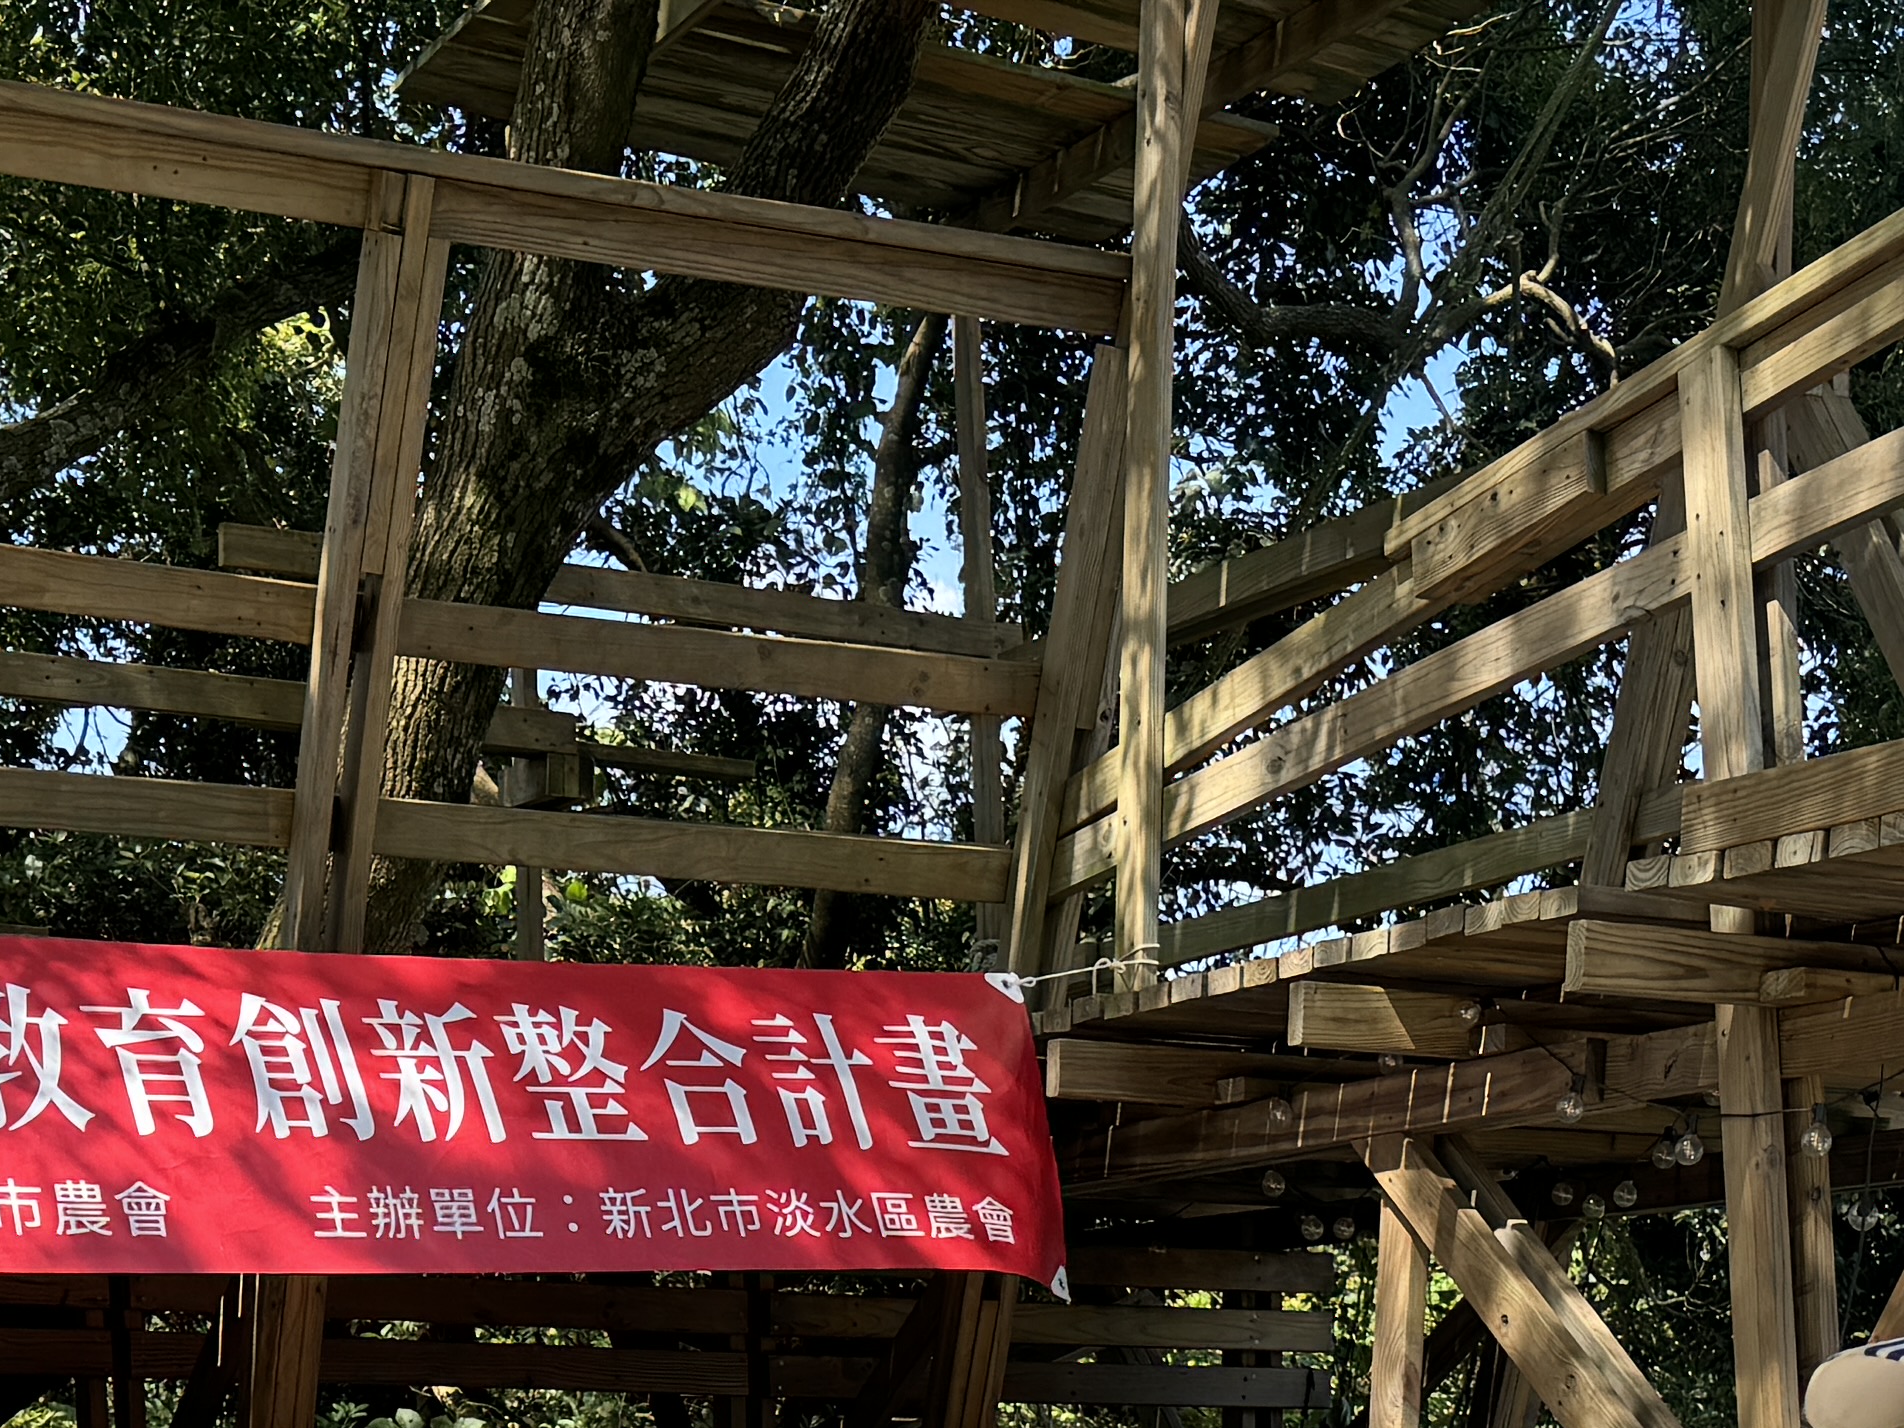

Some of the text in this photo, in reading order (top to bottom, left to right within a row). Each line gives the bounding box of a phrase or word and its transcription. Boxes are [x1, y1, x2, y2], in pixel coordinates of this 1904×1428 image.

[313, 1186, 1016, 1246] 主辦單位：新北市淡水區農會
